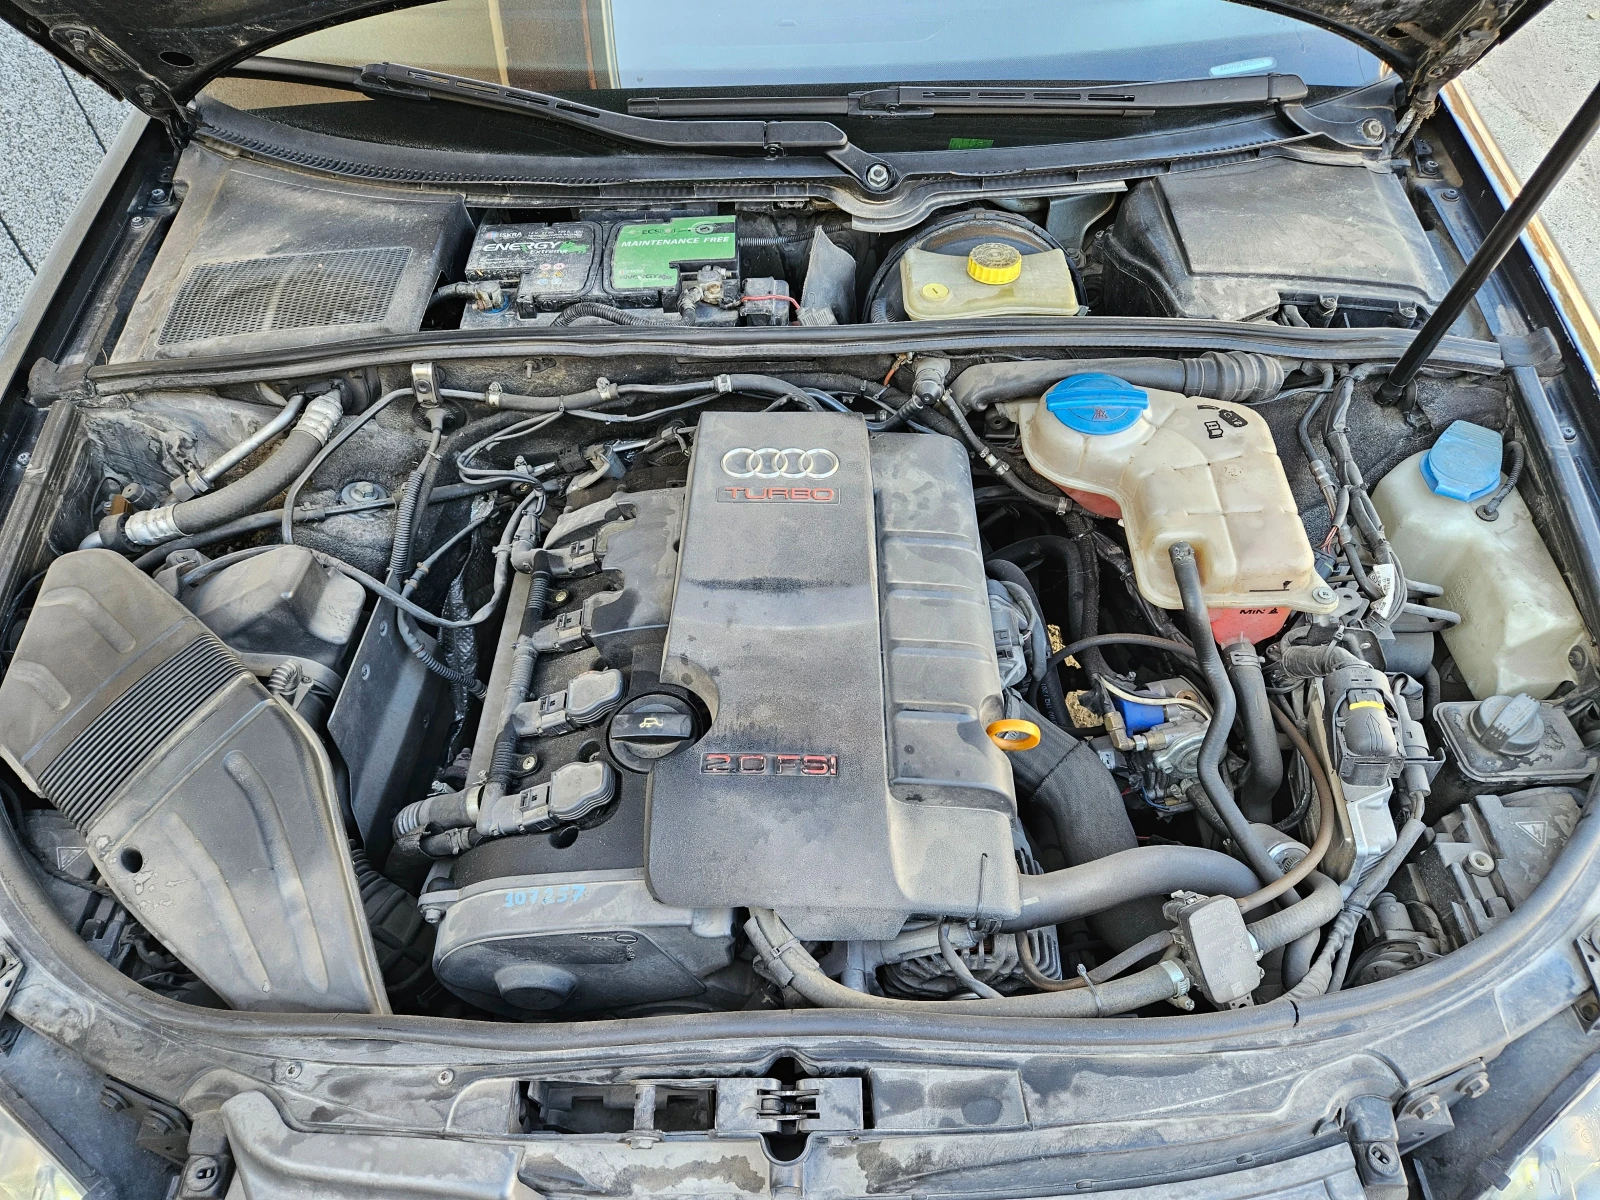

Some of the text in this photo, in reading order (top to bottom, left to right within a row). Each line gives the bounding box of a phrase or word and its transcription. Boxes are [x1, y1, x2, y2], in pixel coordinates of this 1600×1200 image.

[499, 231, 523, 239] ISKRA
[483, 241, 562, 252] ENERGY
[621, 238, 700, 247] MAINTENANCE
[723, 487, 835, 501] TURBO
[776, 754, 838, 775] FSI
